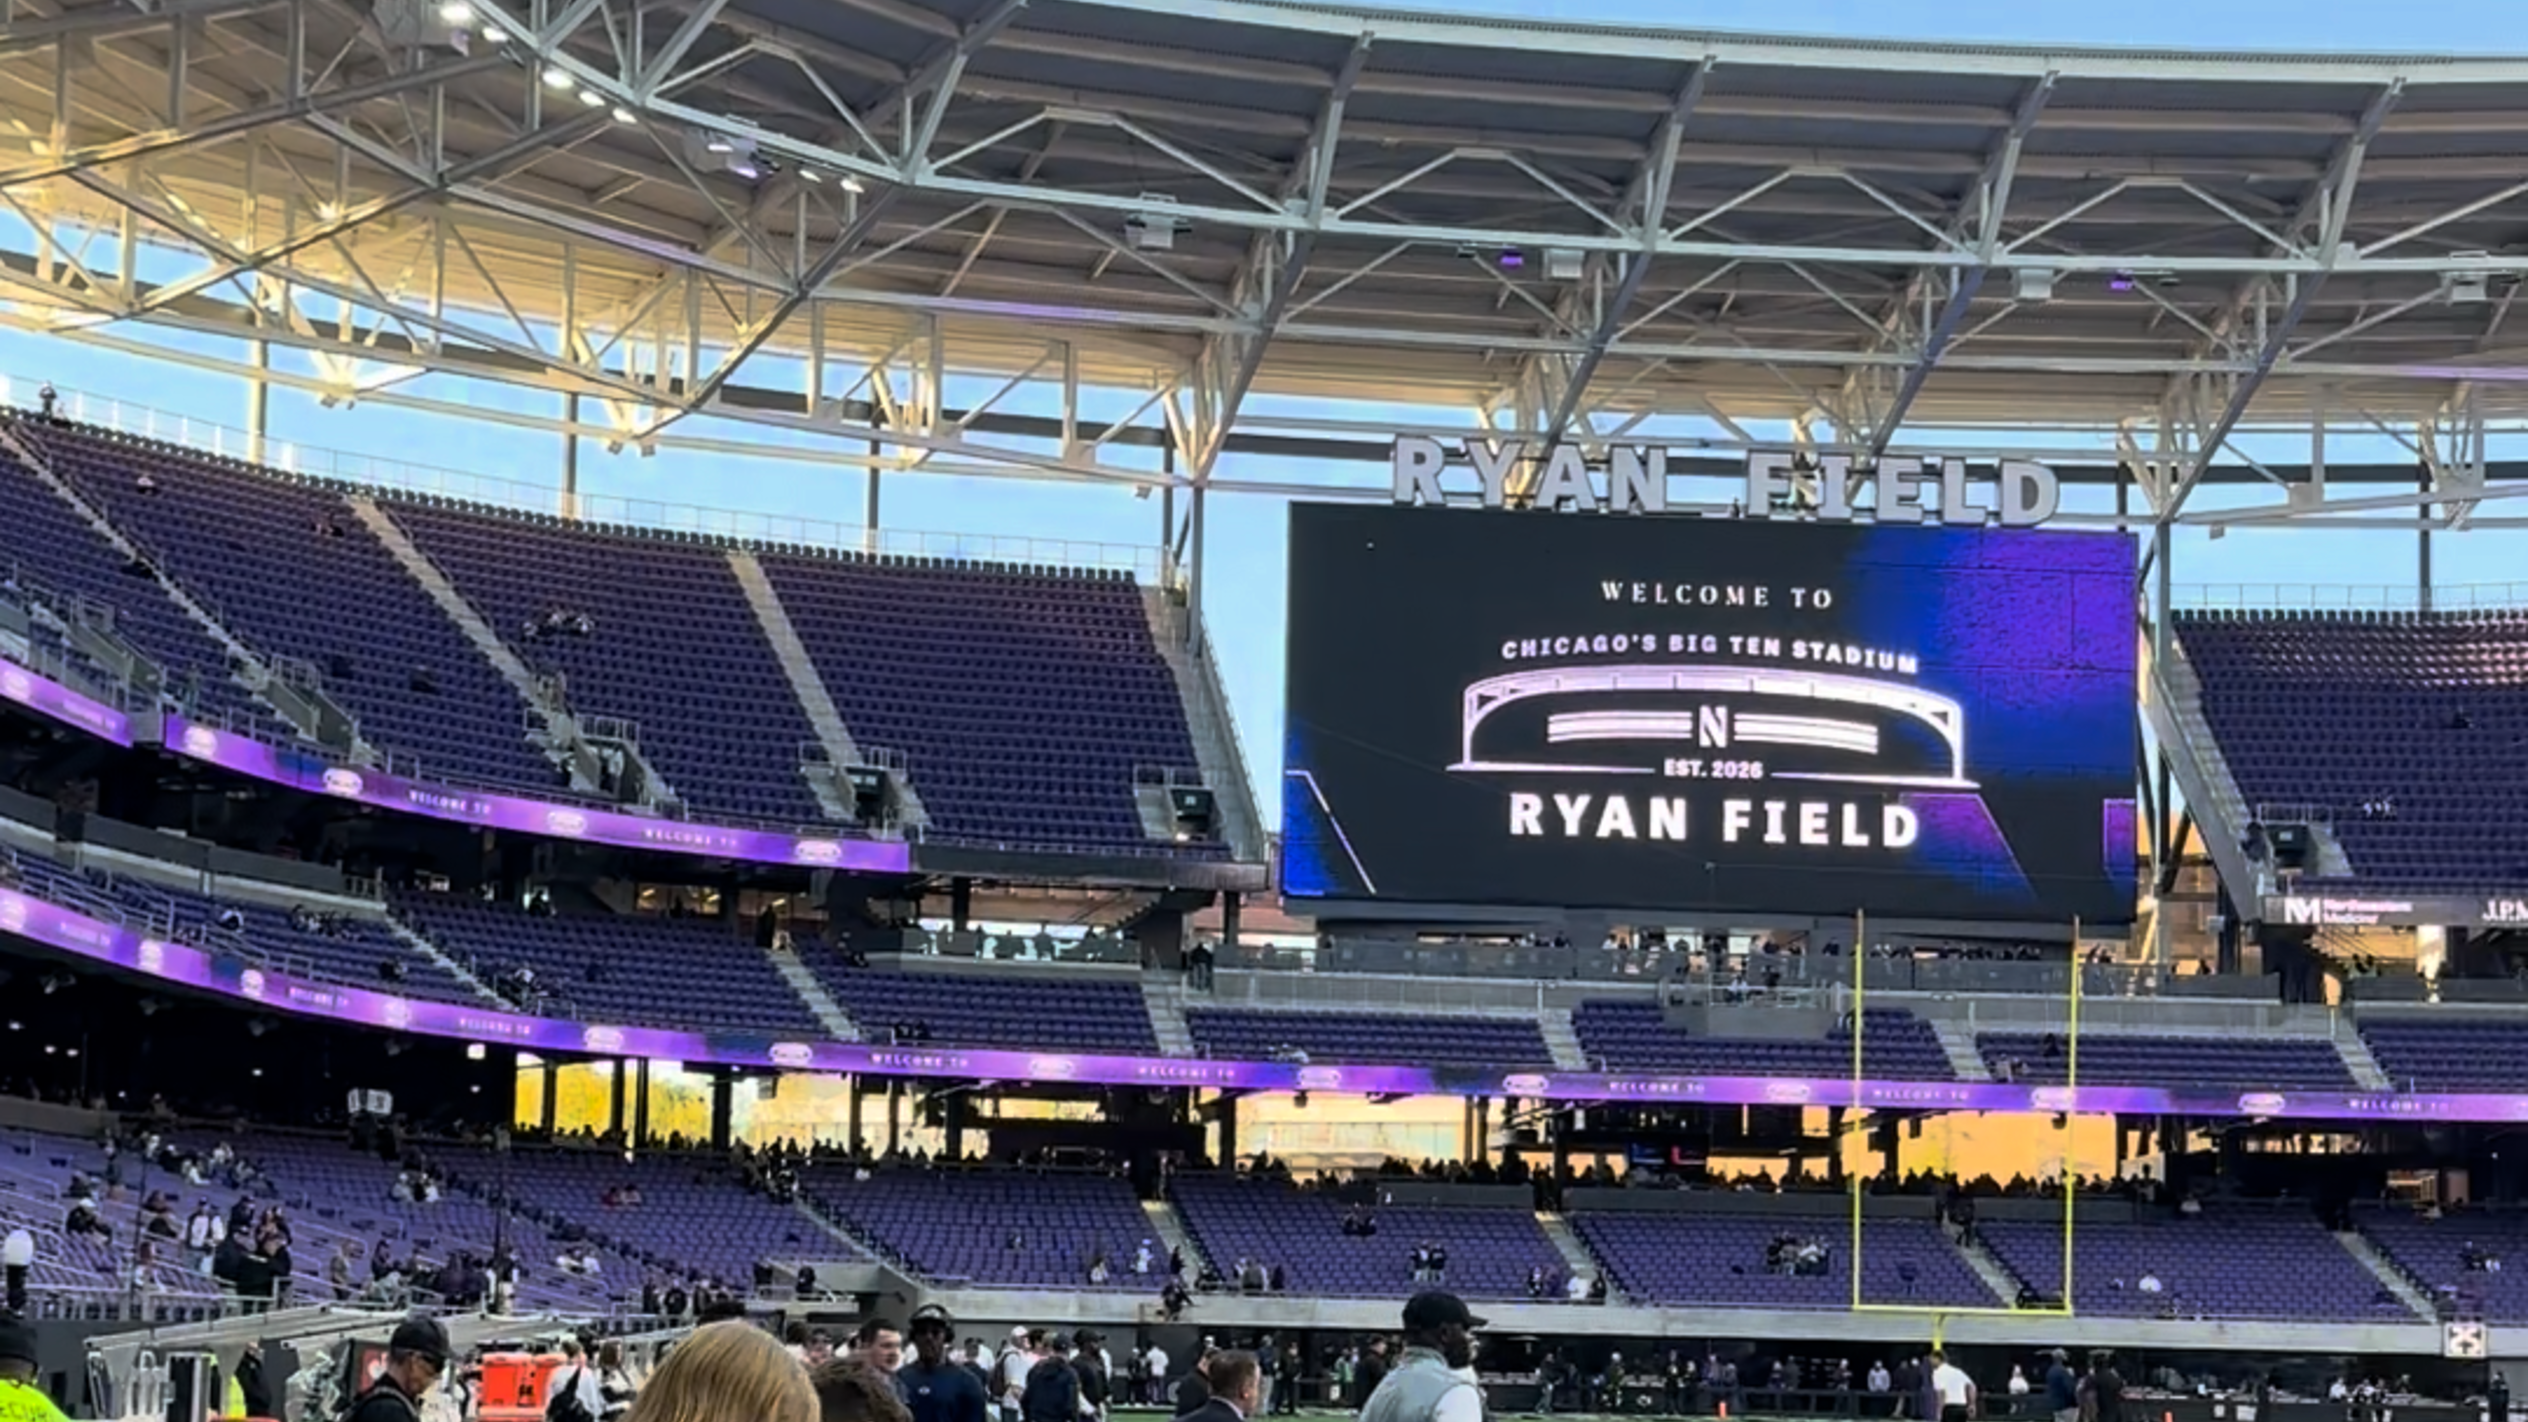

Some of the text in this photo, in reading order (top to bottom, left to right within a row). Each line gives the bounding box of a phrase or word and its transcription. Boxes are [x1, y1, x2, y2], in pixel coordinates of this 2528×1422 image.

[1393, 434, 2060, 528] RYAN FIELD
[1601, 581, 1832, 609] WELCOME TO
[1501, 633, 1919, 675] CHICAGO'S BIG TEN STADIUM
[1699, 704, 1729, 748] N
[1663, 757, 1764, 780] EST. 2026
[1509, 791, 1920, 848] RYAN FIELD
[871, 1053, 943, 1069] WELCOME
[1137, 1065, 1236, 1080] WELCOME TO
[1609, 1081, 1681, 1094] WELCOME
[1873, 1087, 1970, 1102] WELCOME TO
